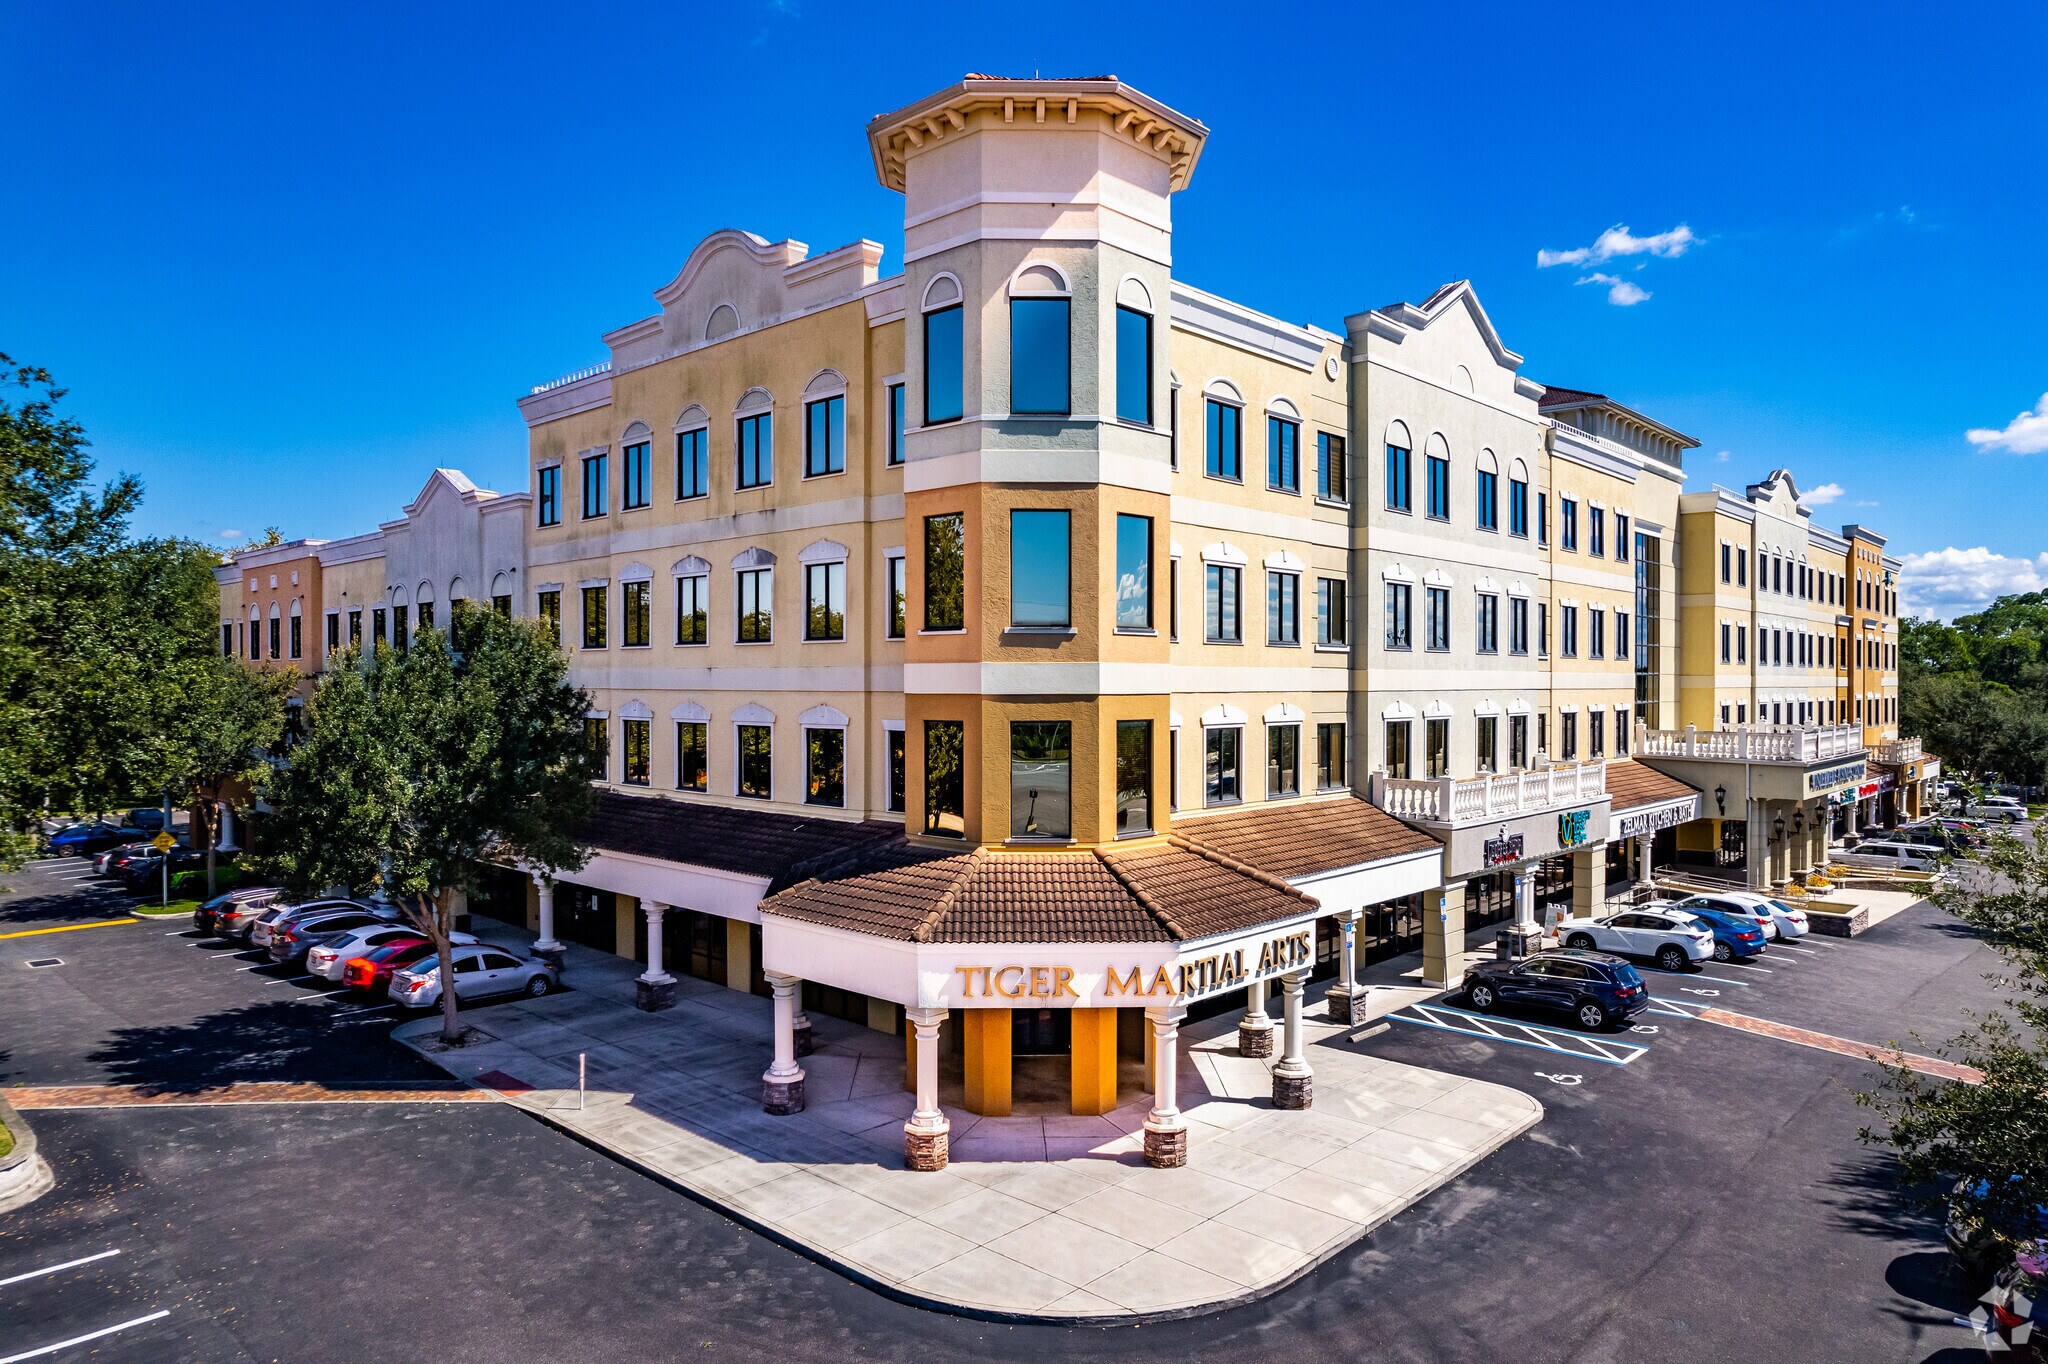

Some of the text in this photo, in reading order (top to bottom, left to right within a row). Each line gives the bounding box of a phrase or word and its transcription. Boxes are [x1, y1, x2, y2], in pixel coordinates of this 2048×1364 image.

[1623, 813, 1648, 834] ZELMAR
[1648, 807, 1673, 828] KITCHEN
[1679, 803, 1692, 820] BATH
[955, 930, 1312, 998] TIGER MARTIAL ARTS
